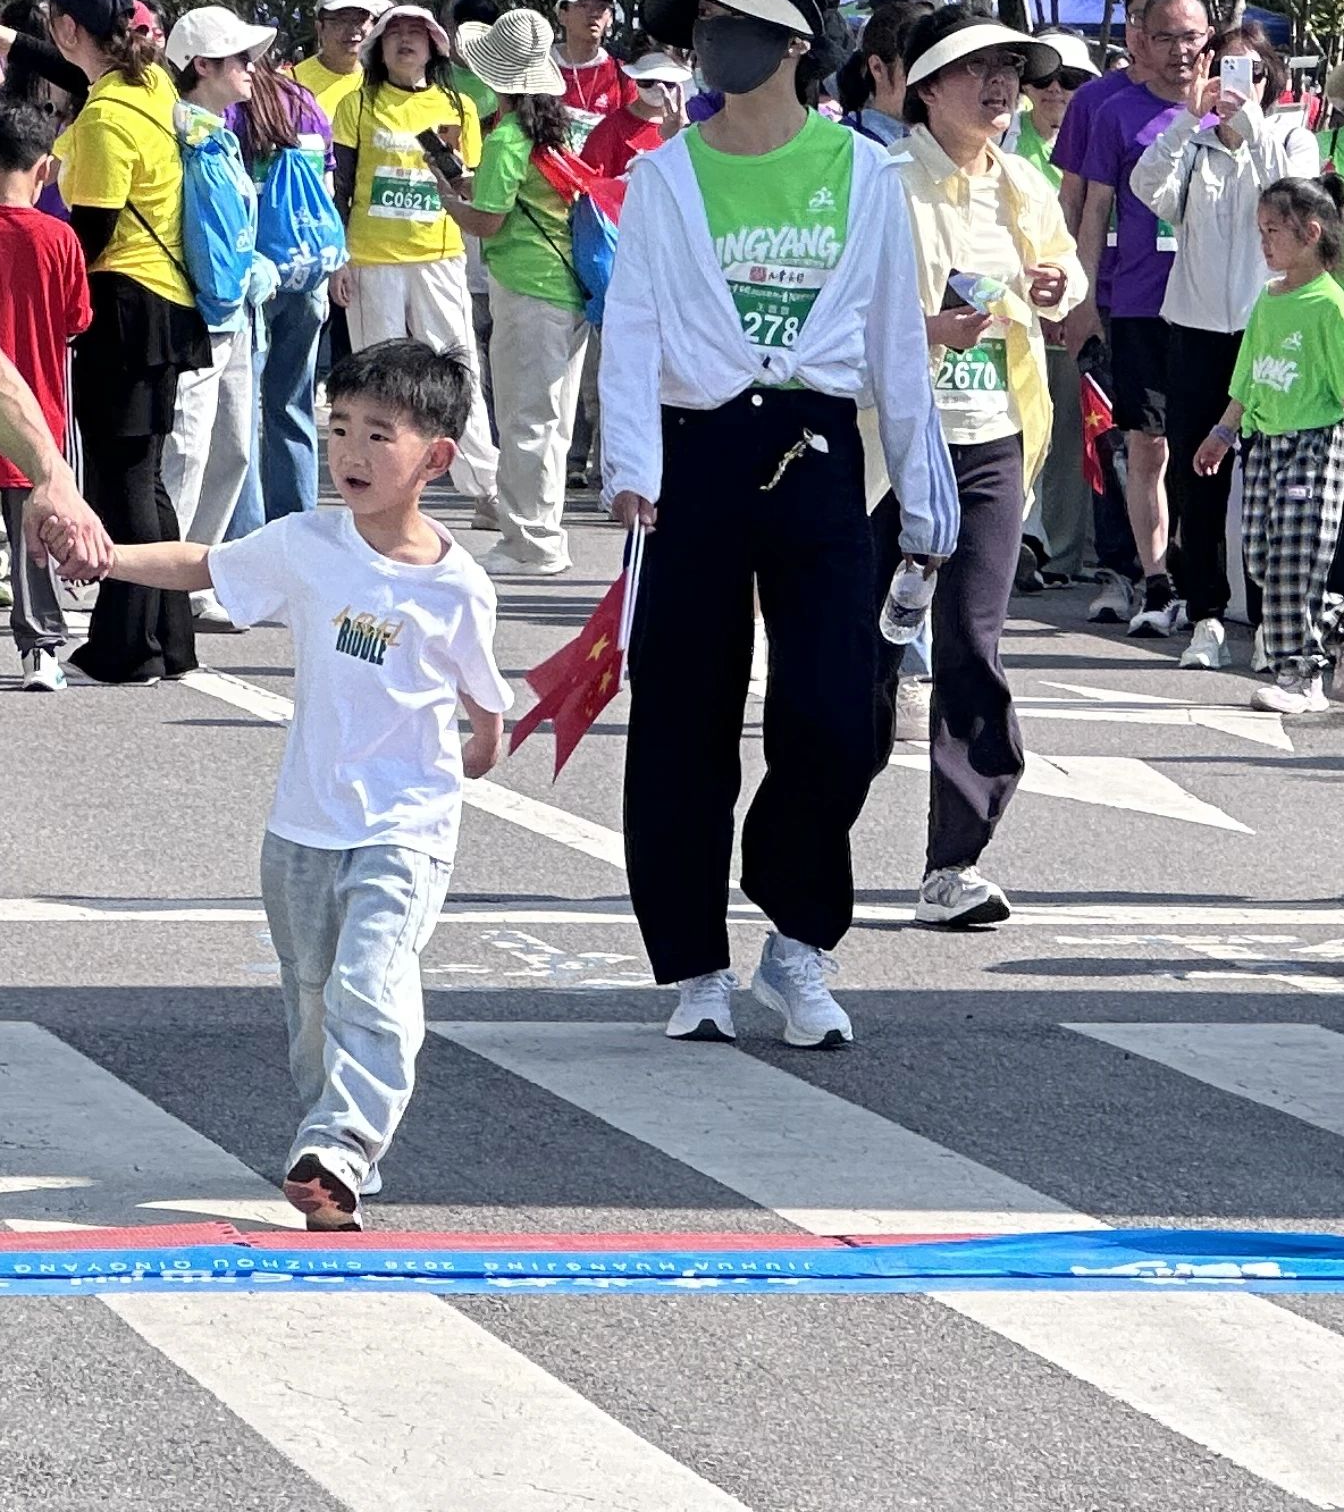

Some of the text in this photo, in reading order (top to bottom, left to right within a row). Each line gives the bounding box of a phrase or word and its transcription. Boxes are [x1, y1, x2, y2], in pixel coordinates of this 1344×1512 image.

[716, 225, 841, 269] INGYANG
[743, 311, 800, 347] 278
[936, 361, 997, 390] 2670
[13, 1259, 193, 1272] QINGYANG
[212, 1258, 362, 1270] CHIZHOU
